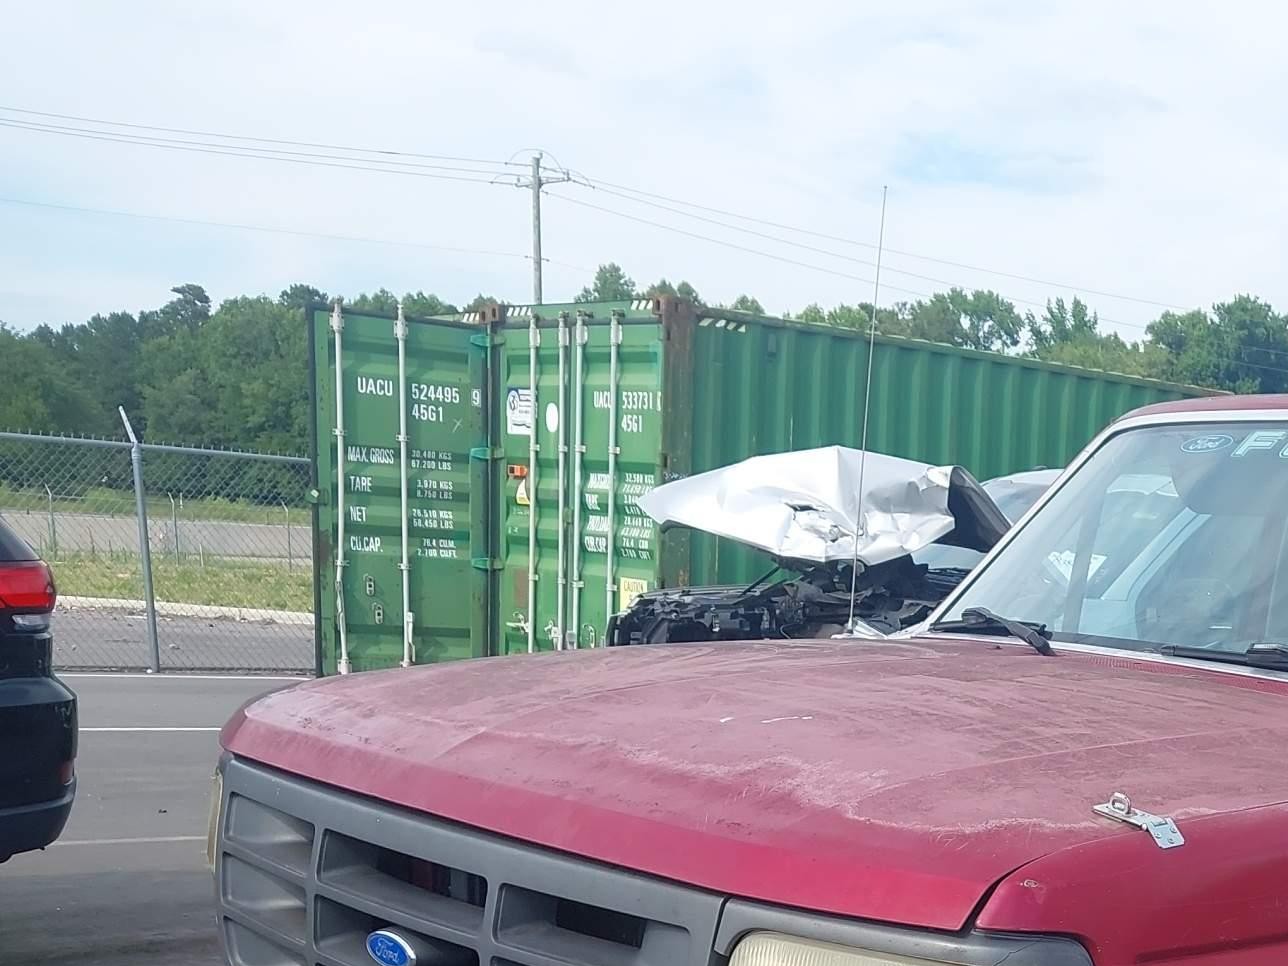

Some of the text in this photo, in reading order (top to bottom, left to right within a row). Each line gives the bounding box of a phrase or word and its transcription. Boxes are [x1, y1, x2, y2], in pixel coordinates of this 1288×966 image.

[357, 376, 481, 407] UACU 524495 9
[622, 391, 653, 410] 533731
[411, 403, 443, 422] 45G1
[621, 414, 643, 433] 45G1
[347, 446, 369, 462] MAX.
[370, 448, 394, 464] GROSS
[438, 452, 453, 461] KGS
[438, 461, 452, 471] LBS
[350, 475, 373, 493] TARE
[439, 480, 453, 490] KGS
[439, 491, 453, 500] LBS
[350, 505, 367, 522] NET
[439, 509, 453, 519] KGS
[440, 520, 454, 529] LBS
[350, 536, 384, 553] CU.CAP.
